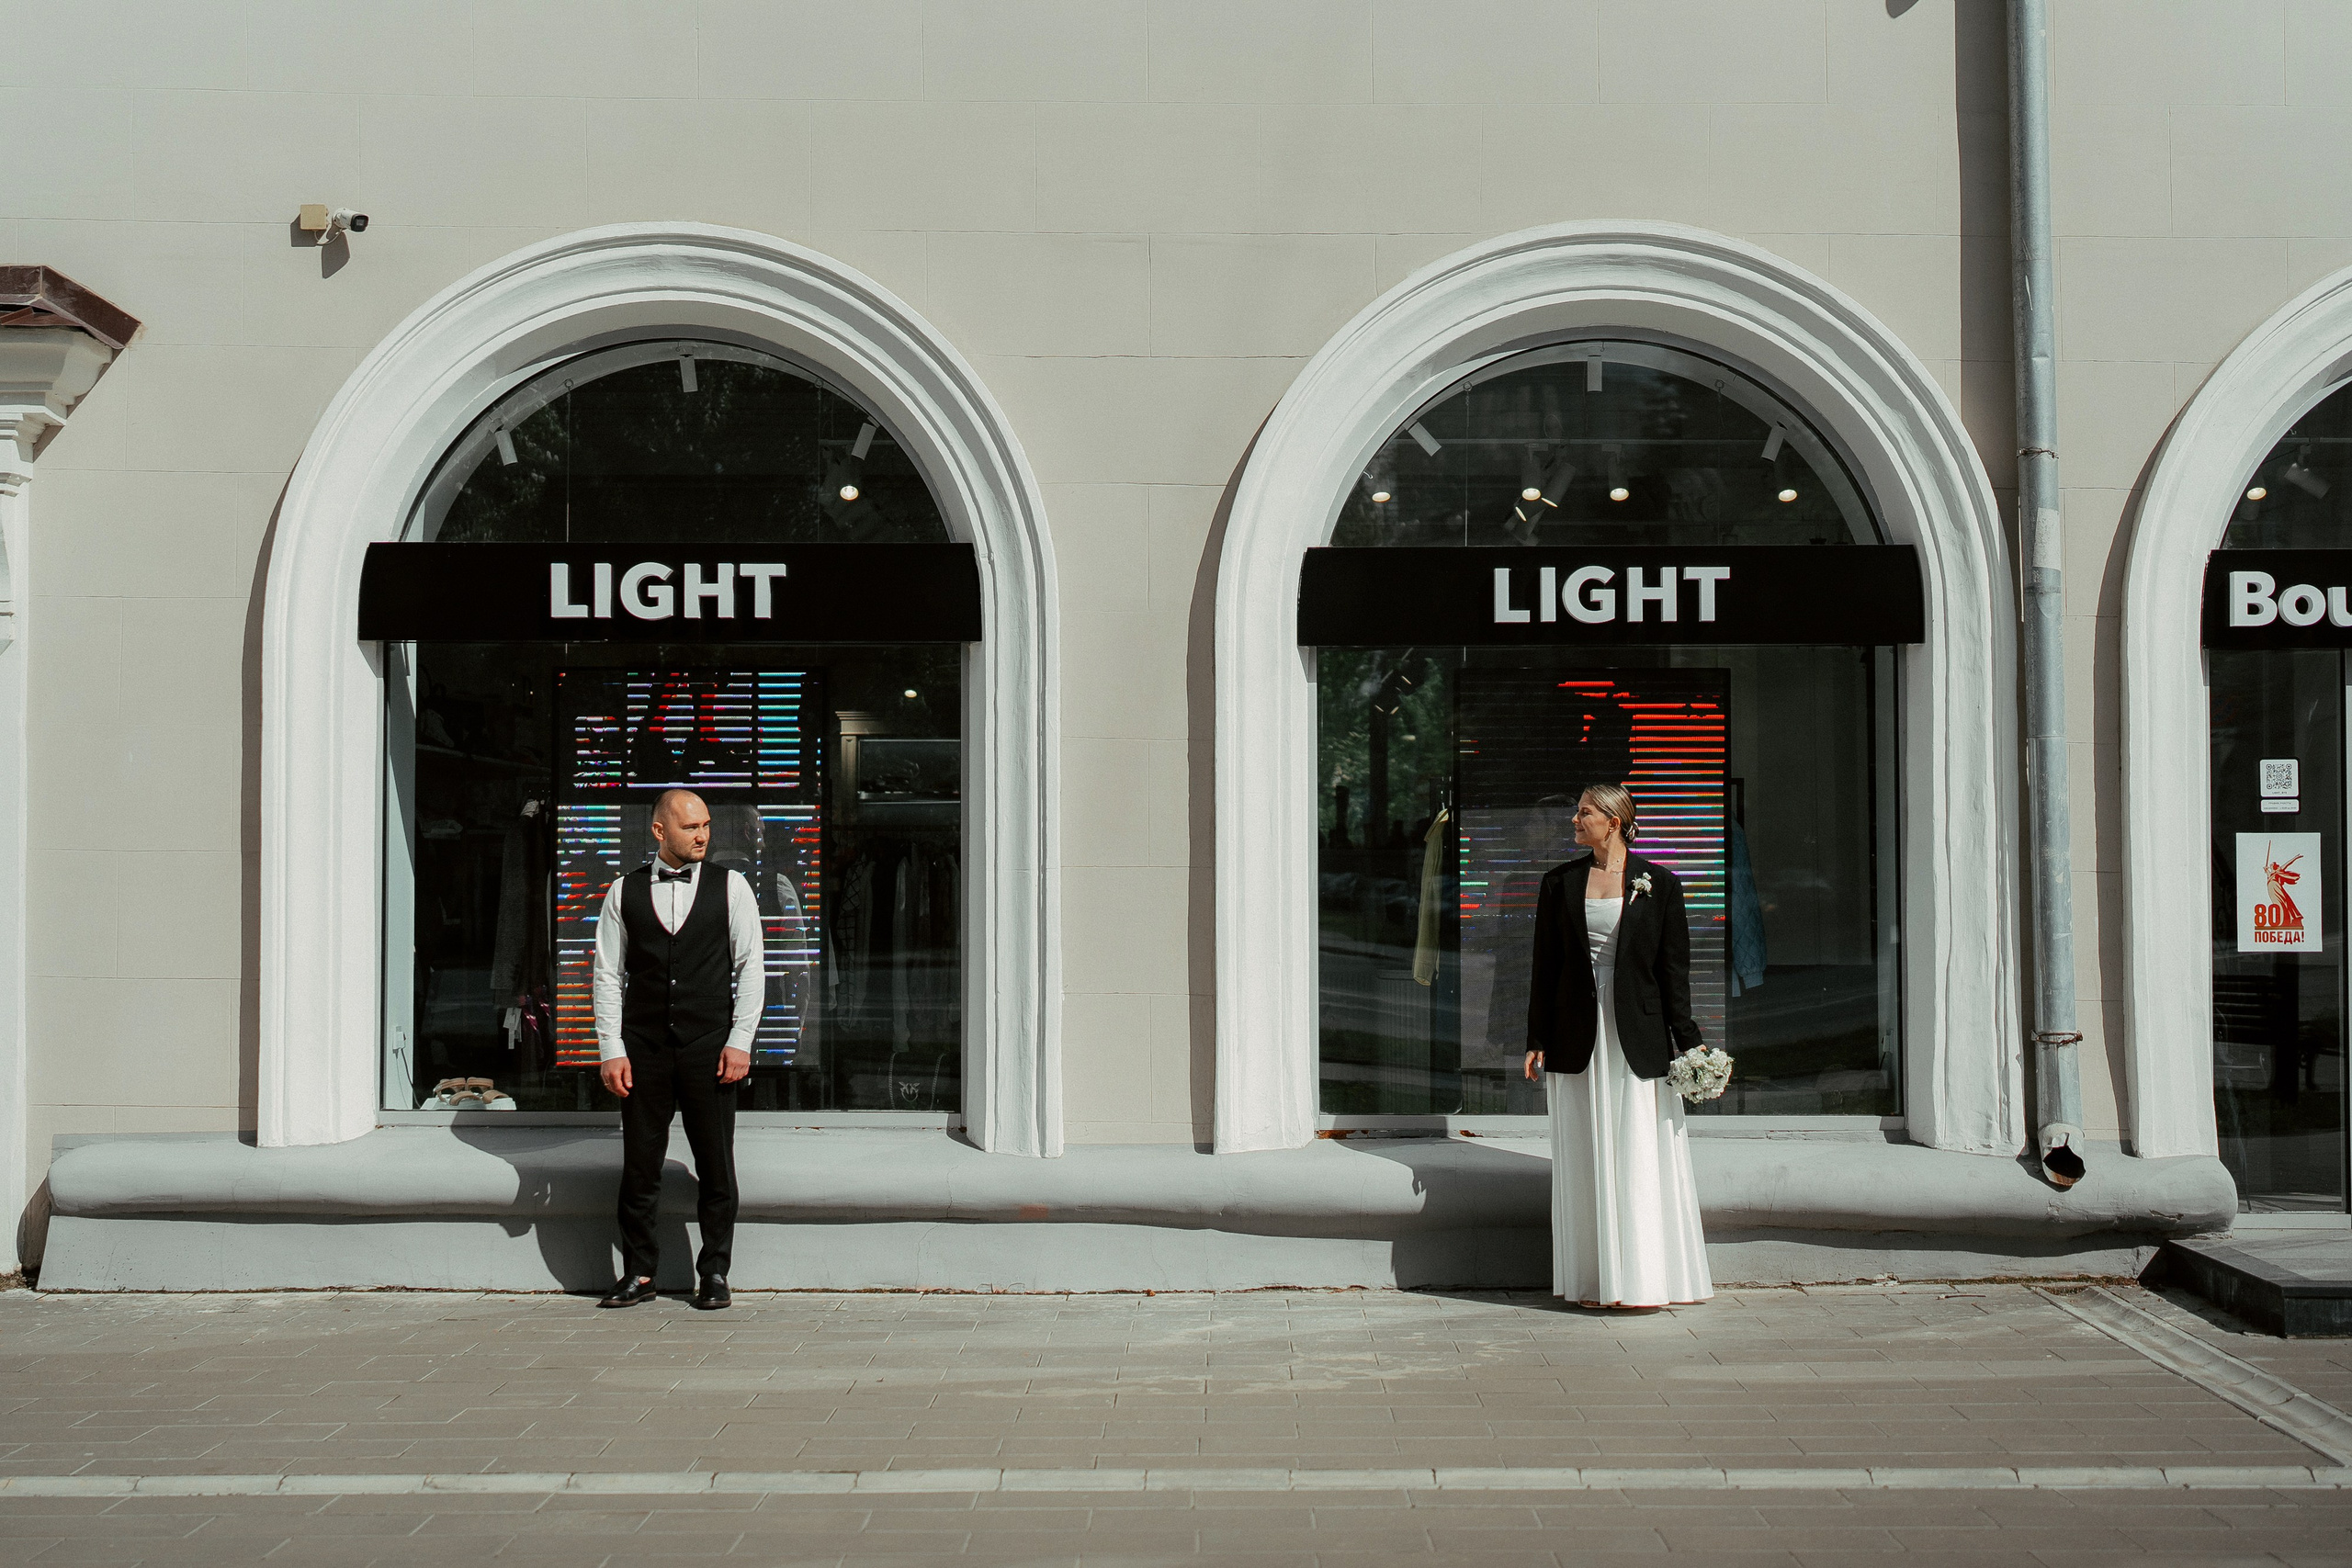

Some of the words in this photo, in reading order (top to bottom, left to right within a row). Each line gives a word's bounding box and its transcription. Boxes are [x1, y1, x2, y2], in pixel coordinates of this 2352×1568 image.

[549, 561, 788, 620] LIGHT
[1493, 565, 1732, 624] LIGHT
[2228, 570, 2352, 627] Bou
[2254, 903, 2281, 927] 80
[2254, 931, 2305, 944] ПОБЕДА!
